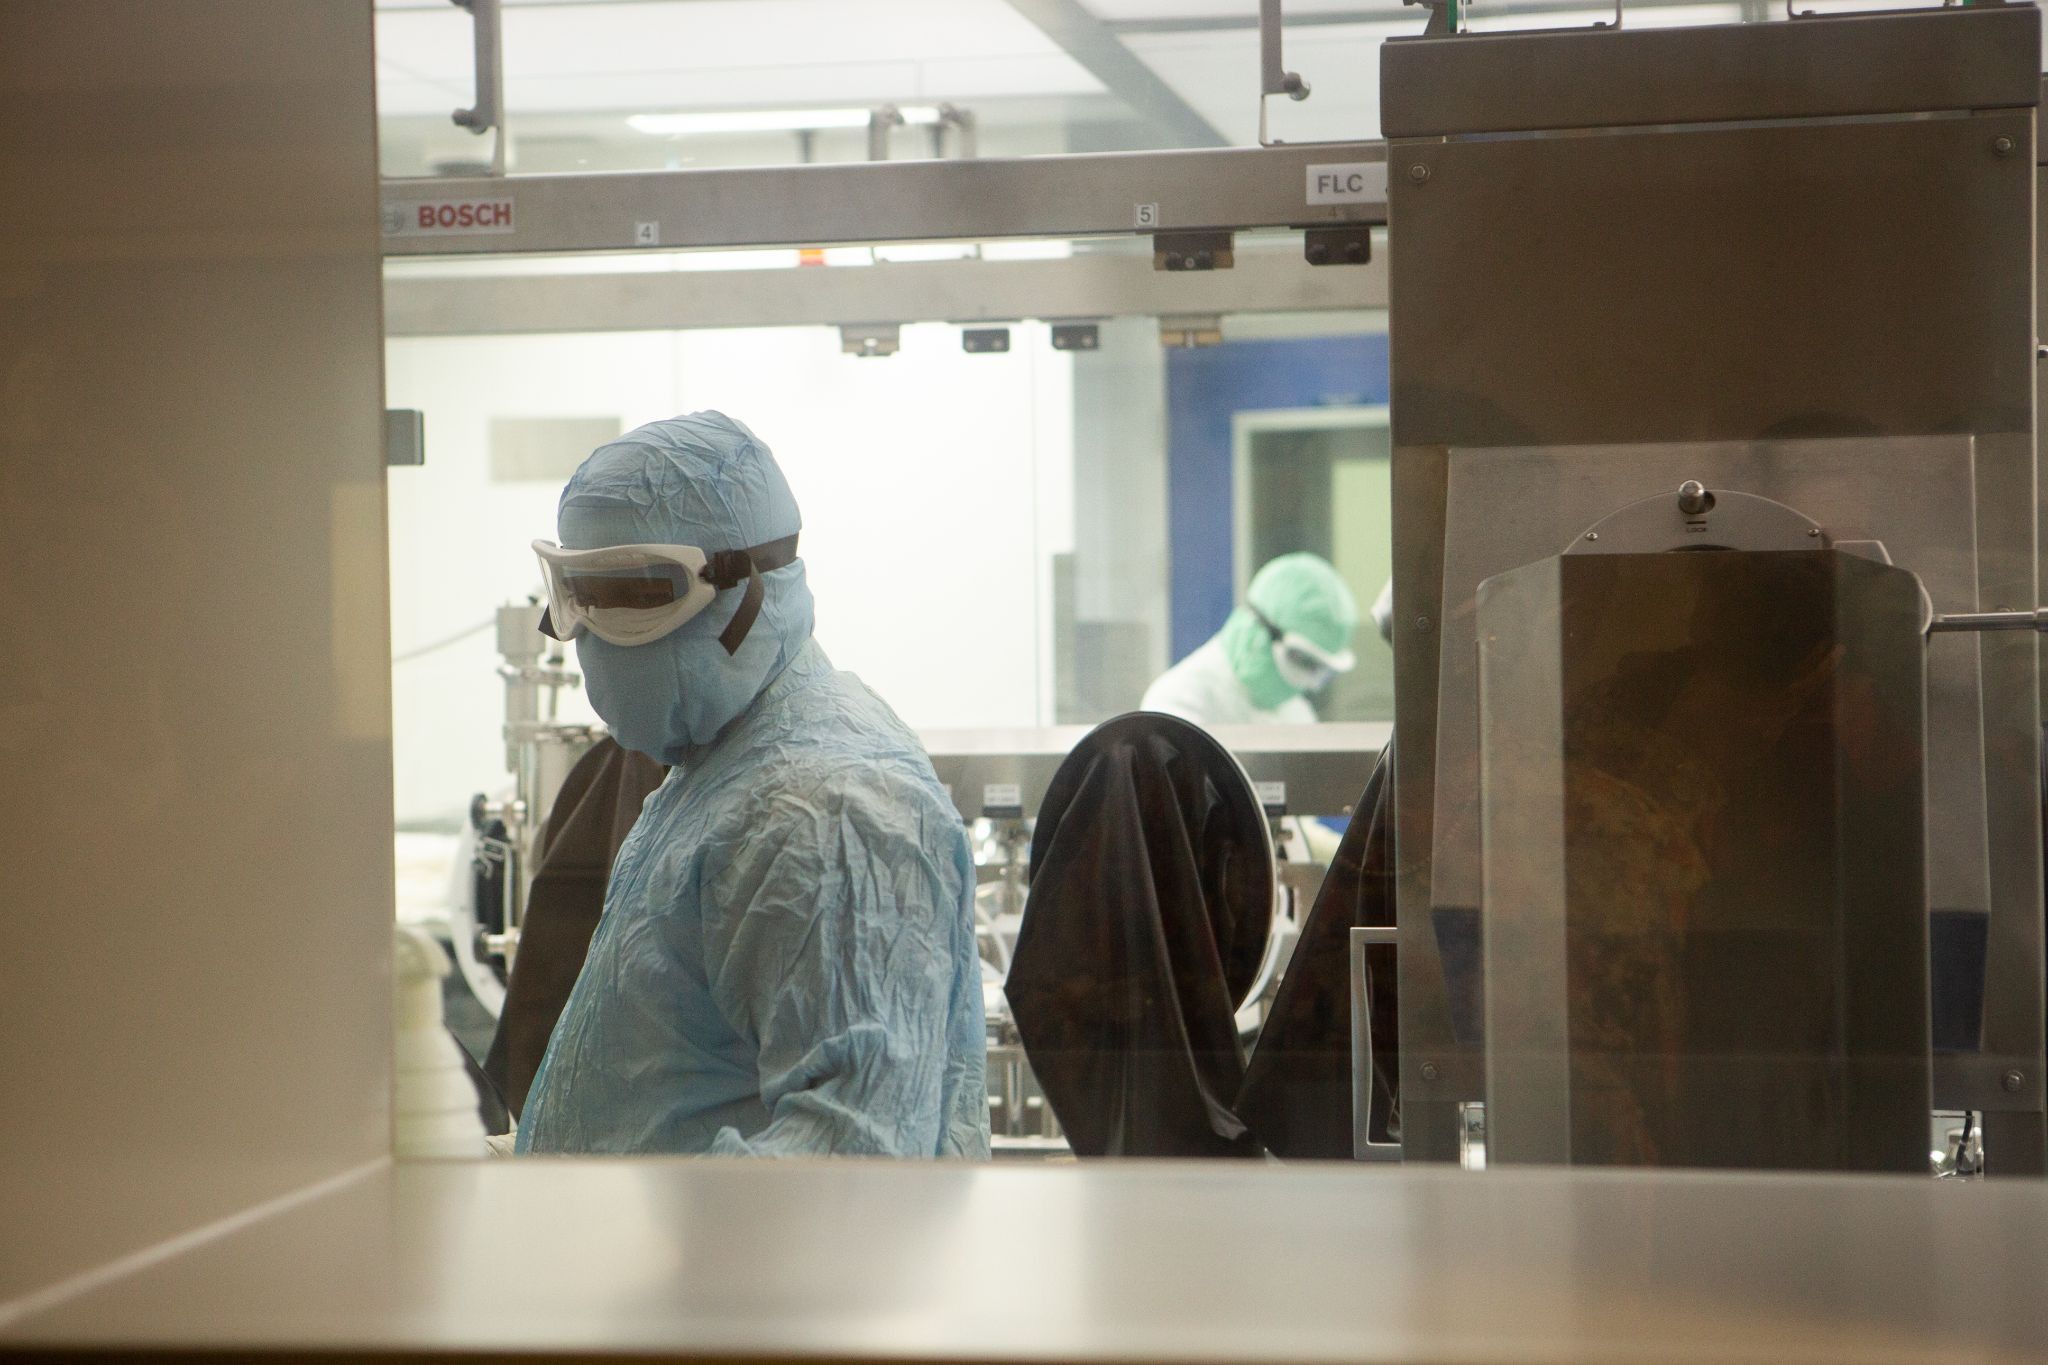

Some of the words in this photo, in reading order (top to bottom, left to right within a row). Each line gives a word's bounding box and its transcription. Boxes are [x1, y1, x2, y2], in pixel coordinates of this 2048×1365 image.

[1317, 174, 1363, 194] FLC
[418, 204, 512, 227] BOSCH
[1140, 206, 1151, 223] 5
[641, 225, 652, 239] 4
